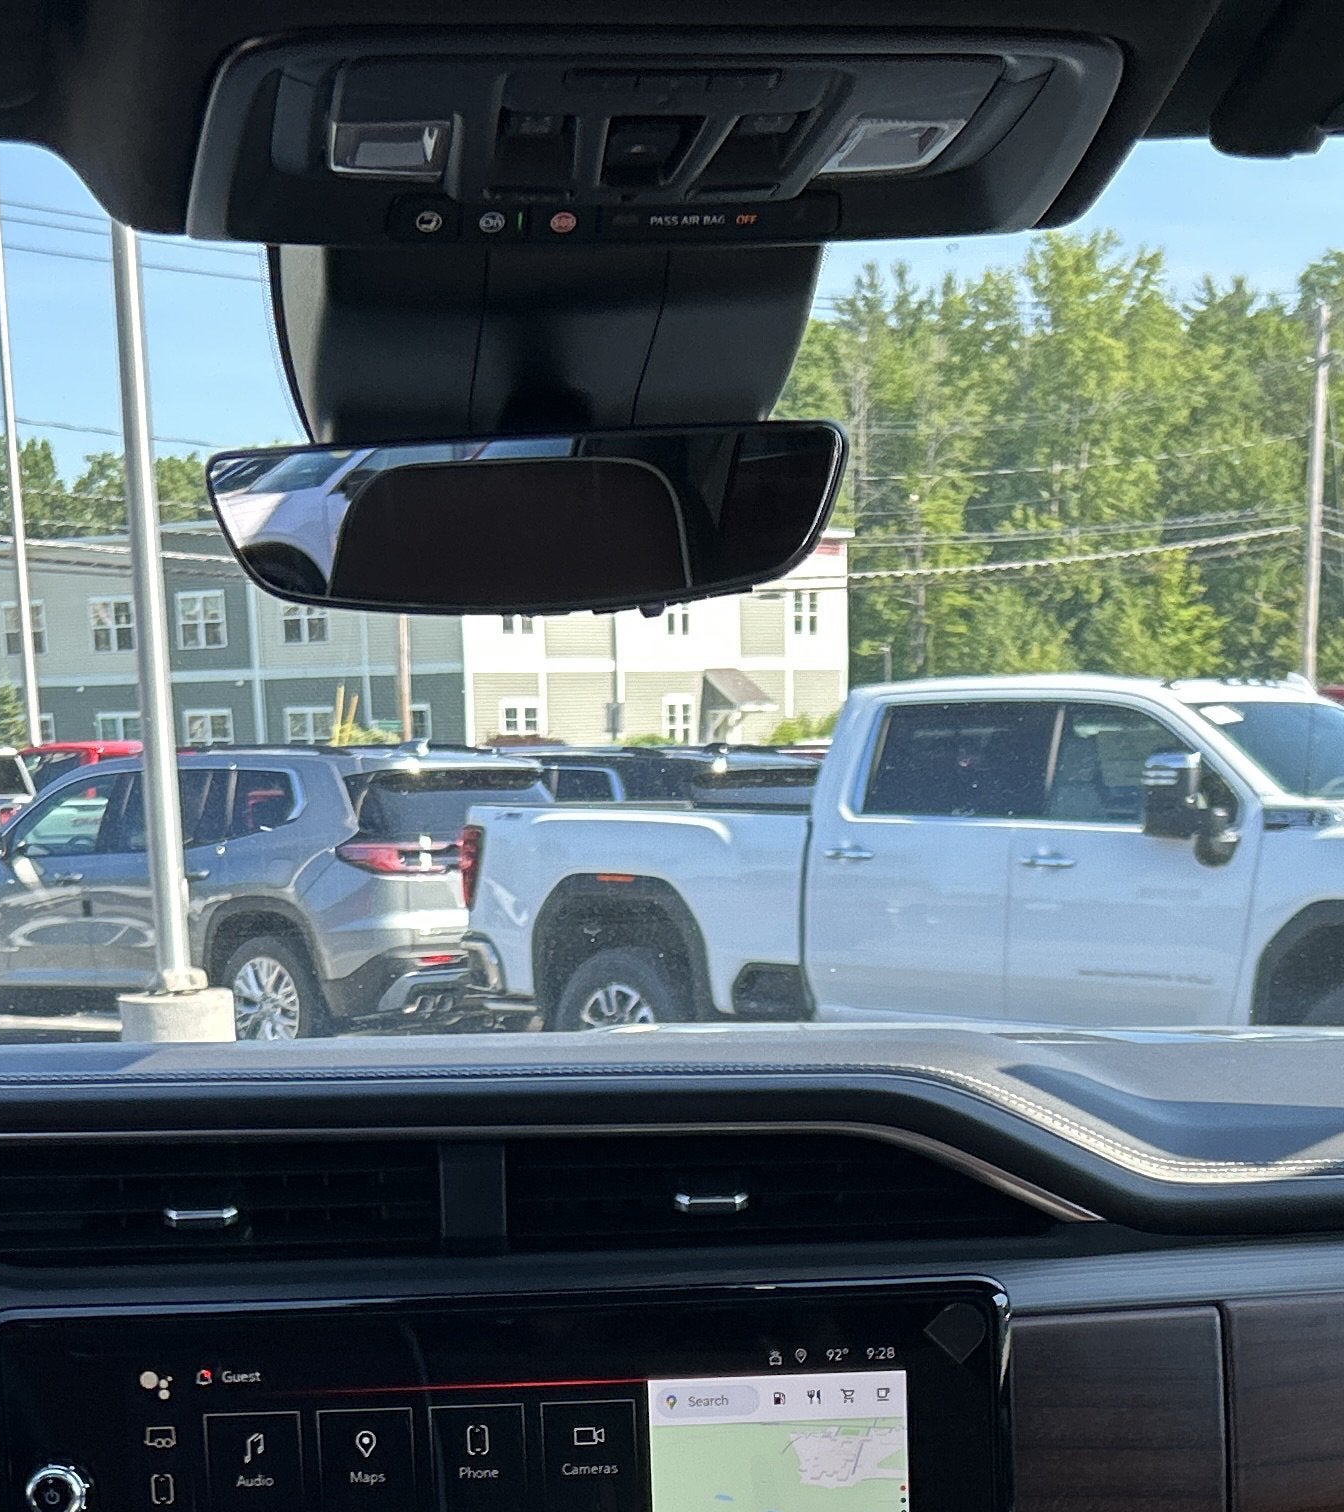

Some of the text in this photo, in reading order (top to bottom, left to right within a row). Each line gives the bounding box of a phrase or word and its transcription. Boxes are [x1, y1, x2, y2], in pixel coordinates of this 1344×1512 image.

[650, 214, 758, 226] PASS AIR BAG OFF
[826, 1346, 896, 1362] 92° 9:28
[221, 1370, 262, 1384] Guest
[688, 1394, 729, 1408] Search
[458, 1466, 500, 1479] Phone
[561, 1463, 619, 1476] Cameras
[236, 1474, 275, 1488] Audio
[349, 1470, 387, 1486] Maps
